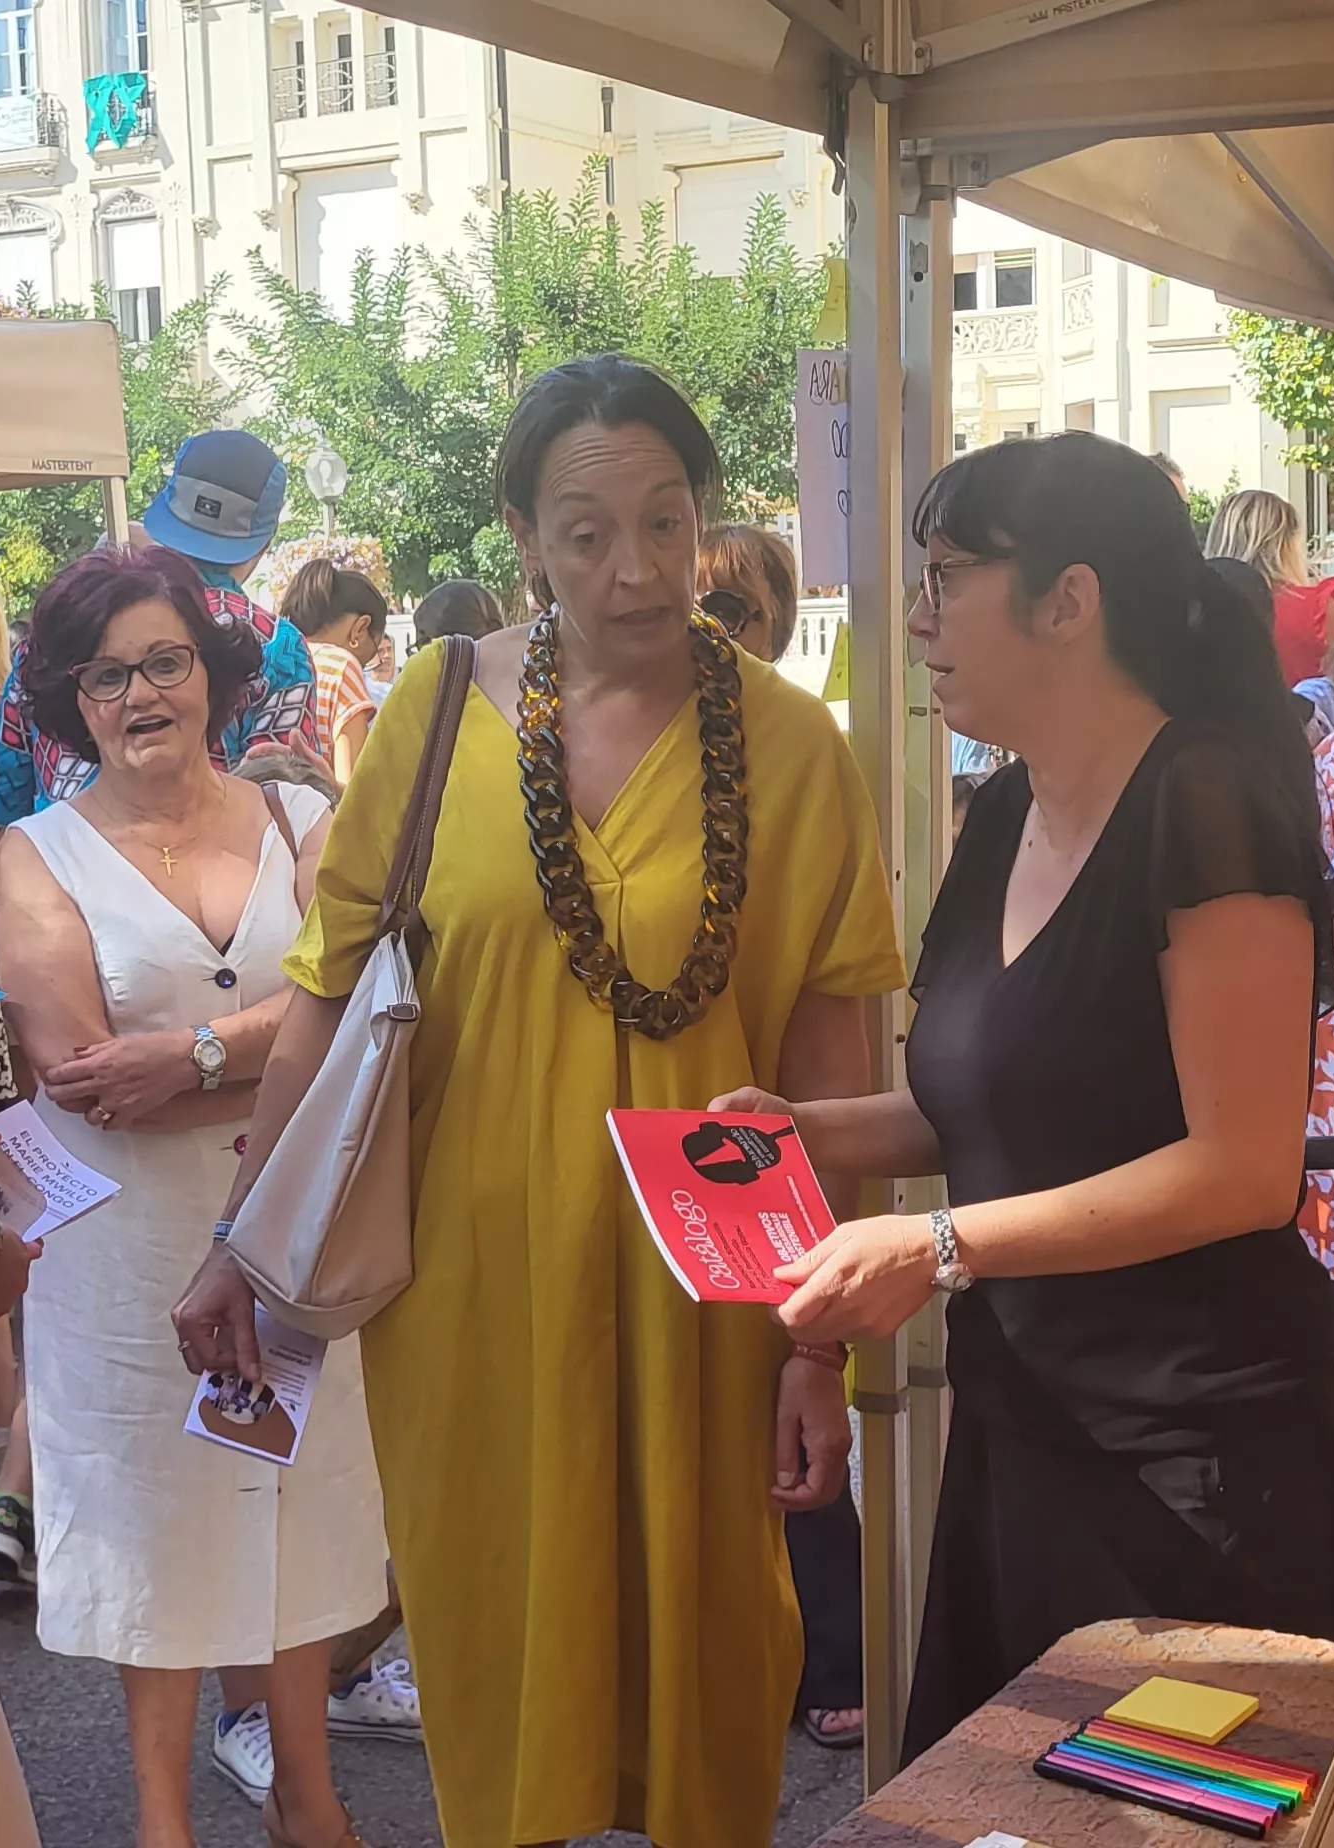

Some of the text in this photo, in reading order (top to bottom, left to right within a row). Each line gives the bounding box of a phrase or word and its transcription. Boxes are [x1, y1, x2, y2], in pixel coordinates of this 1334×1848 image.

[32, 459, 94, 471] MASTERTENT
[9, 1137, 42, 1175] MARIE
[41, 1174, 89, 1204] MWILU
[19, 1129, 33, 1146] EL
[32, 1147, 98, 1197] PROYECTO
[27, 1174, 75, 1209] CONGO
[671, 1189, 740, 1289] Catálogo
[758, 1212, 791, 1262] OBJETIVOS
[777, 1212, 806, 1257] OSTENIBLE
